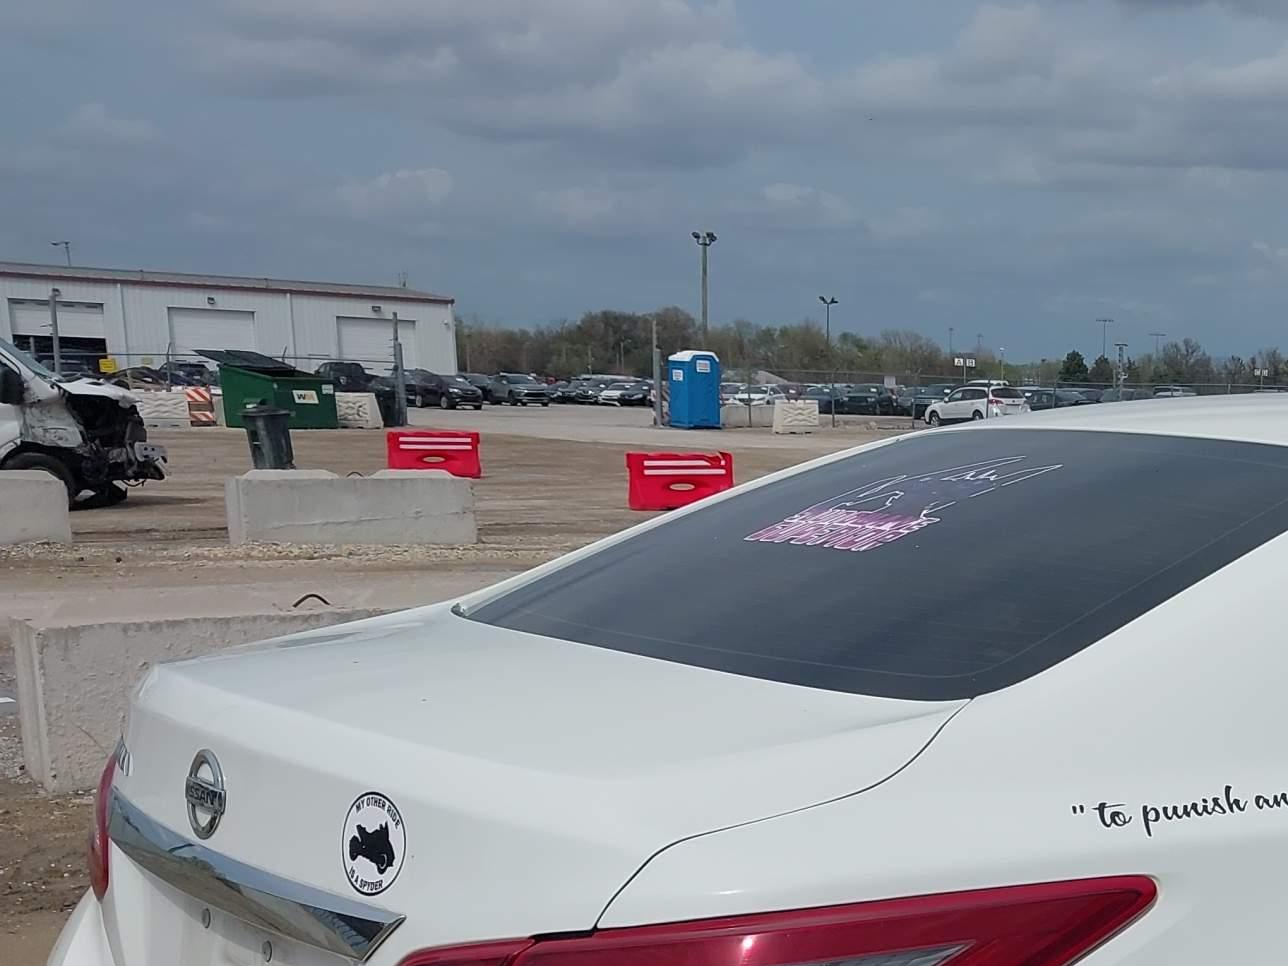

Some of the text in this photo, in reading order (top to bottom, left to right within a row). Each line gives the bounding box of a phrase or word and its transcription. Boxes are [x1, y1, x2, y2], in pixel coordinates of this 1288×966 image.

[355, 796, 400, 830] MY OTHER RIDE
[1142, 785, 1247, 837] punish
[349, 866, 384, 891] IS A SPYDER
